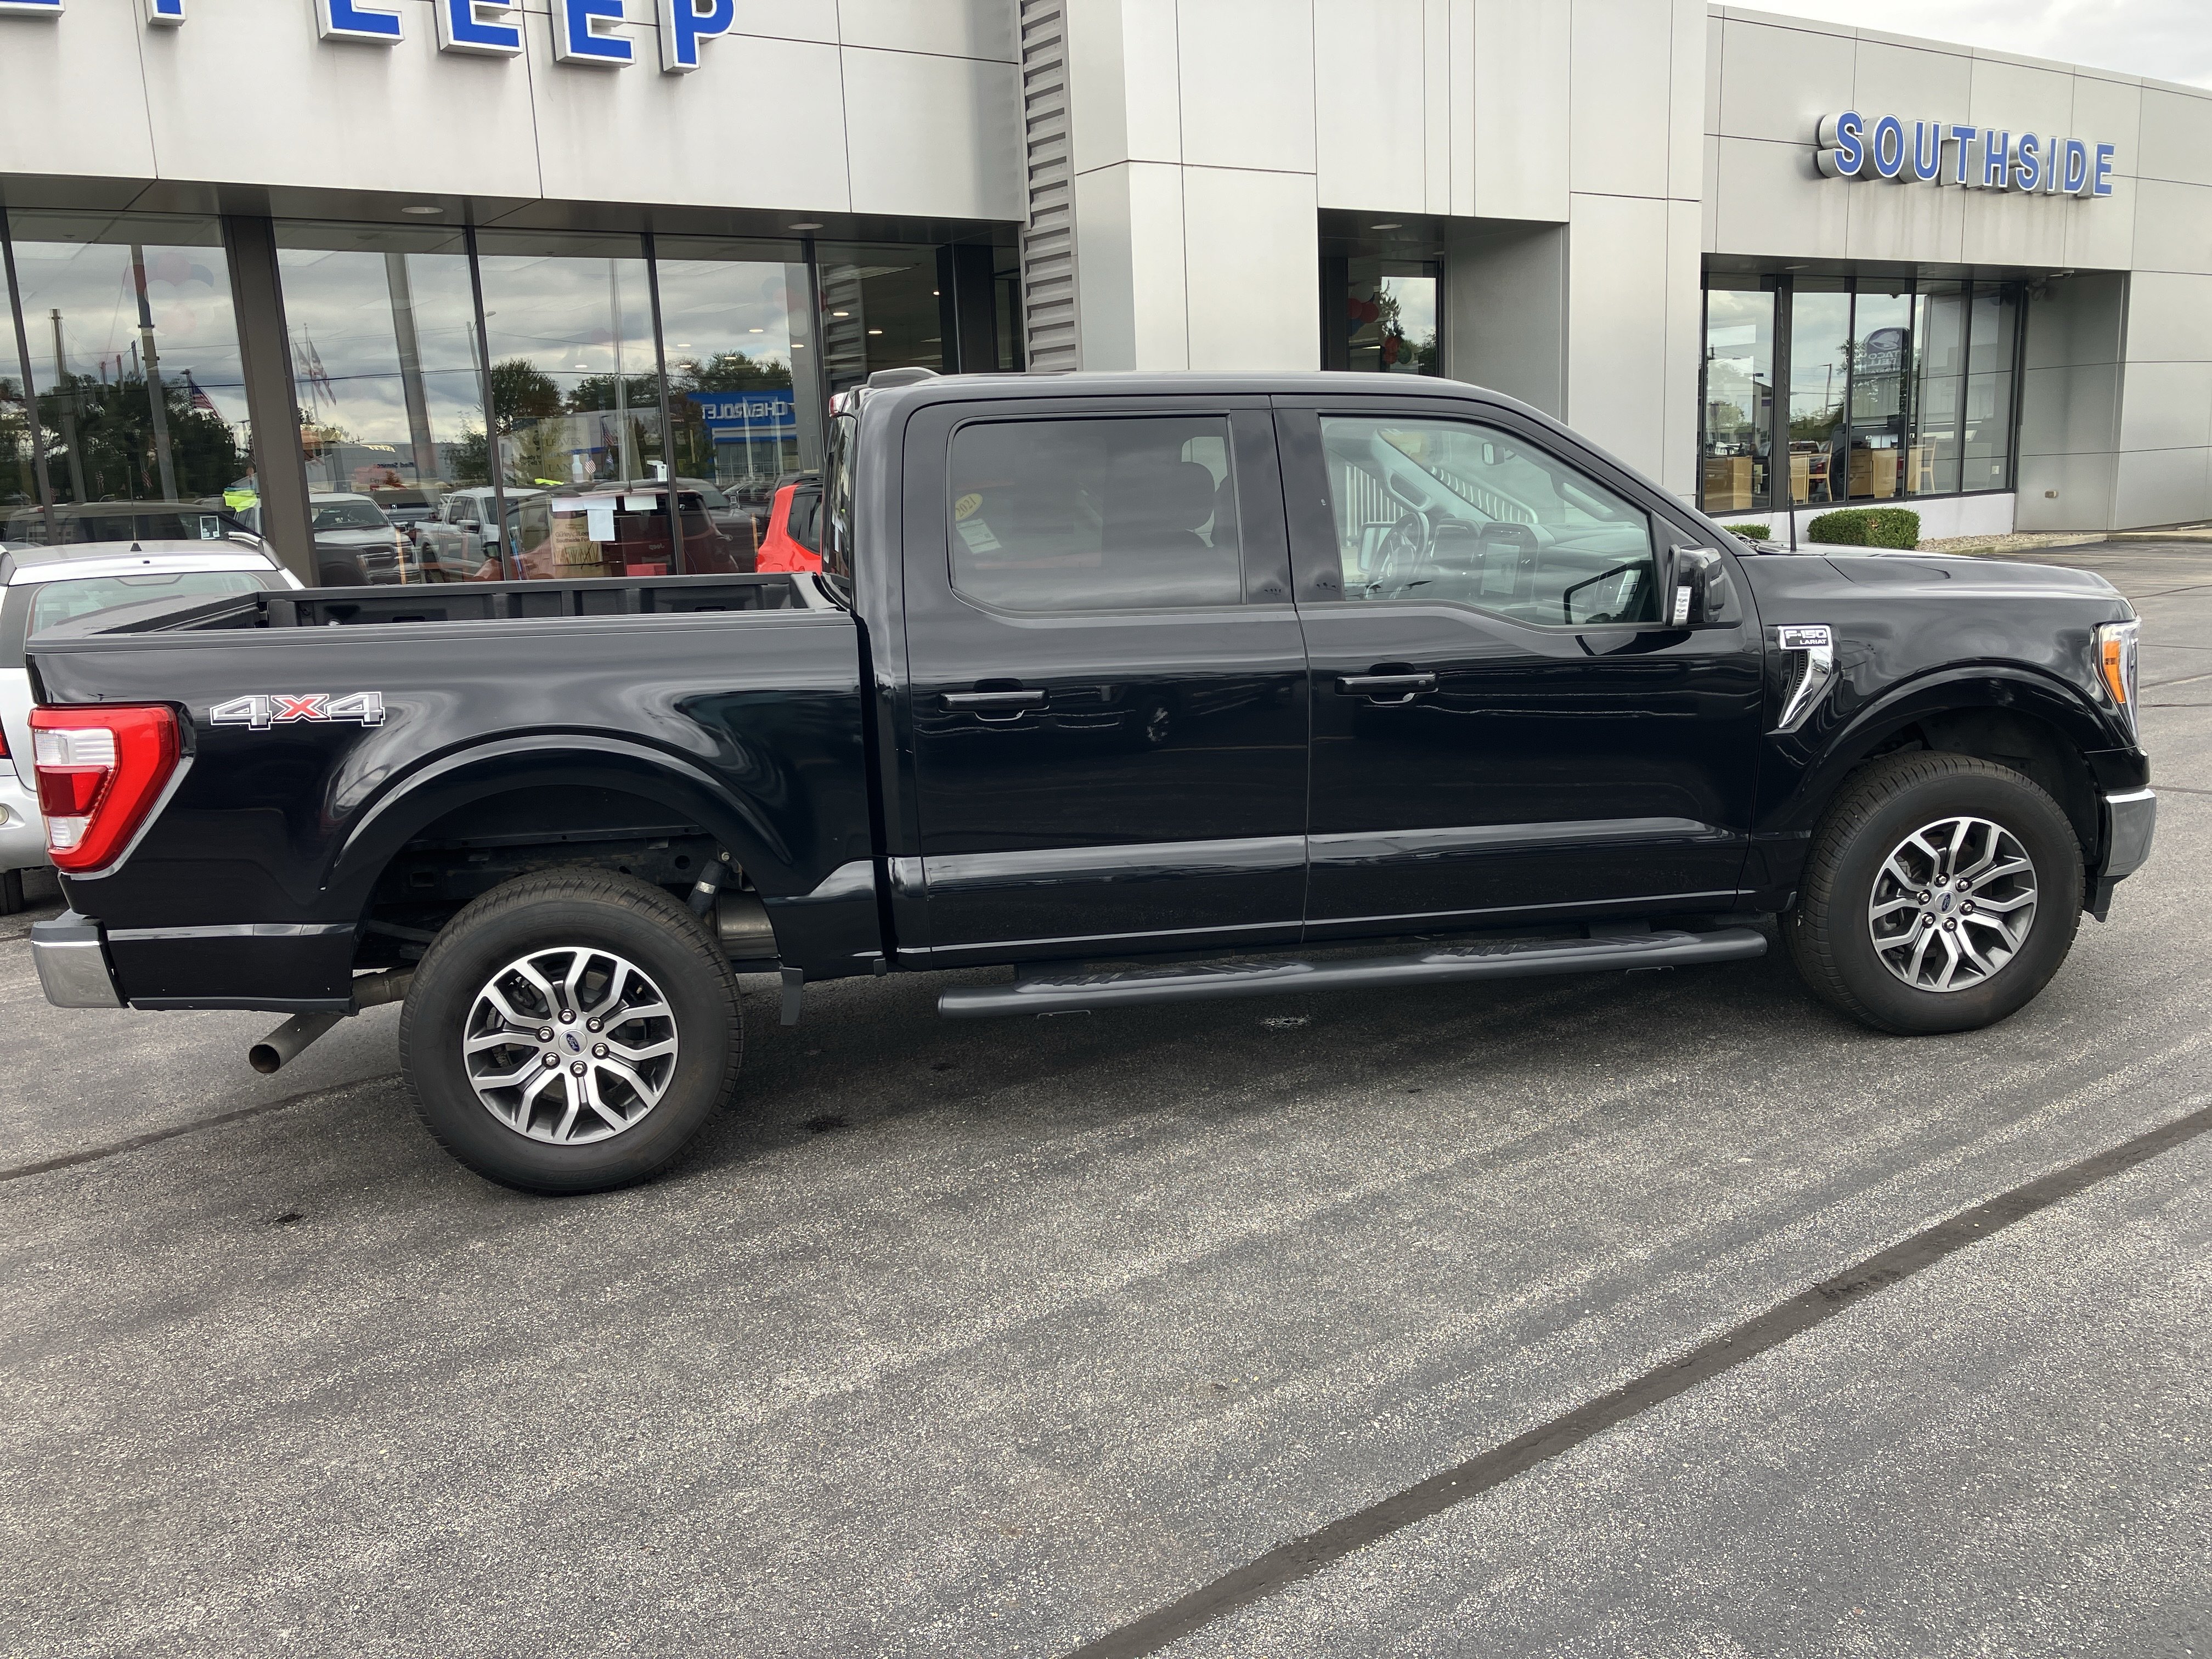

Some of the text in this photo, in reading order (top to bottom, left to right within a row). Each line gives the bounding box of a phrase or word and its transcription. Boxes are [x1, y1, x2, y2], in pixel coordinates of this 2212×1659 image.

[1833, 110, 2117, 198] SOUTHSIDE
[956, 496, 977, 518] 2021
[1785, 630, 1827, 639] F-150
[567, 1036, 579, 1050] Ford
